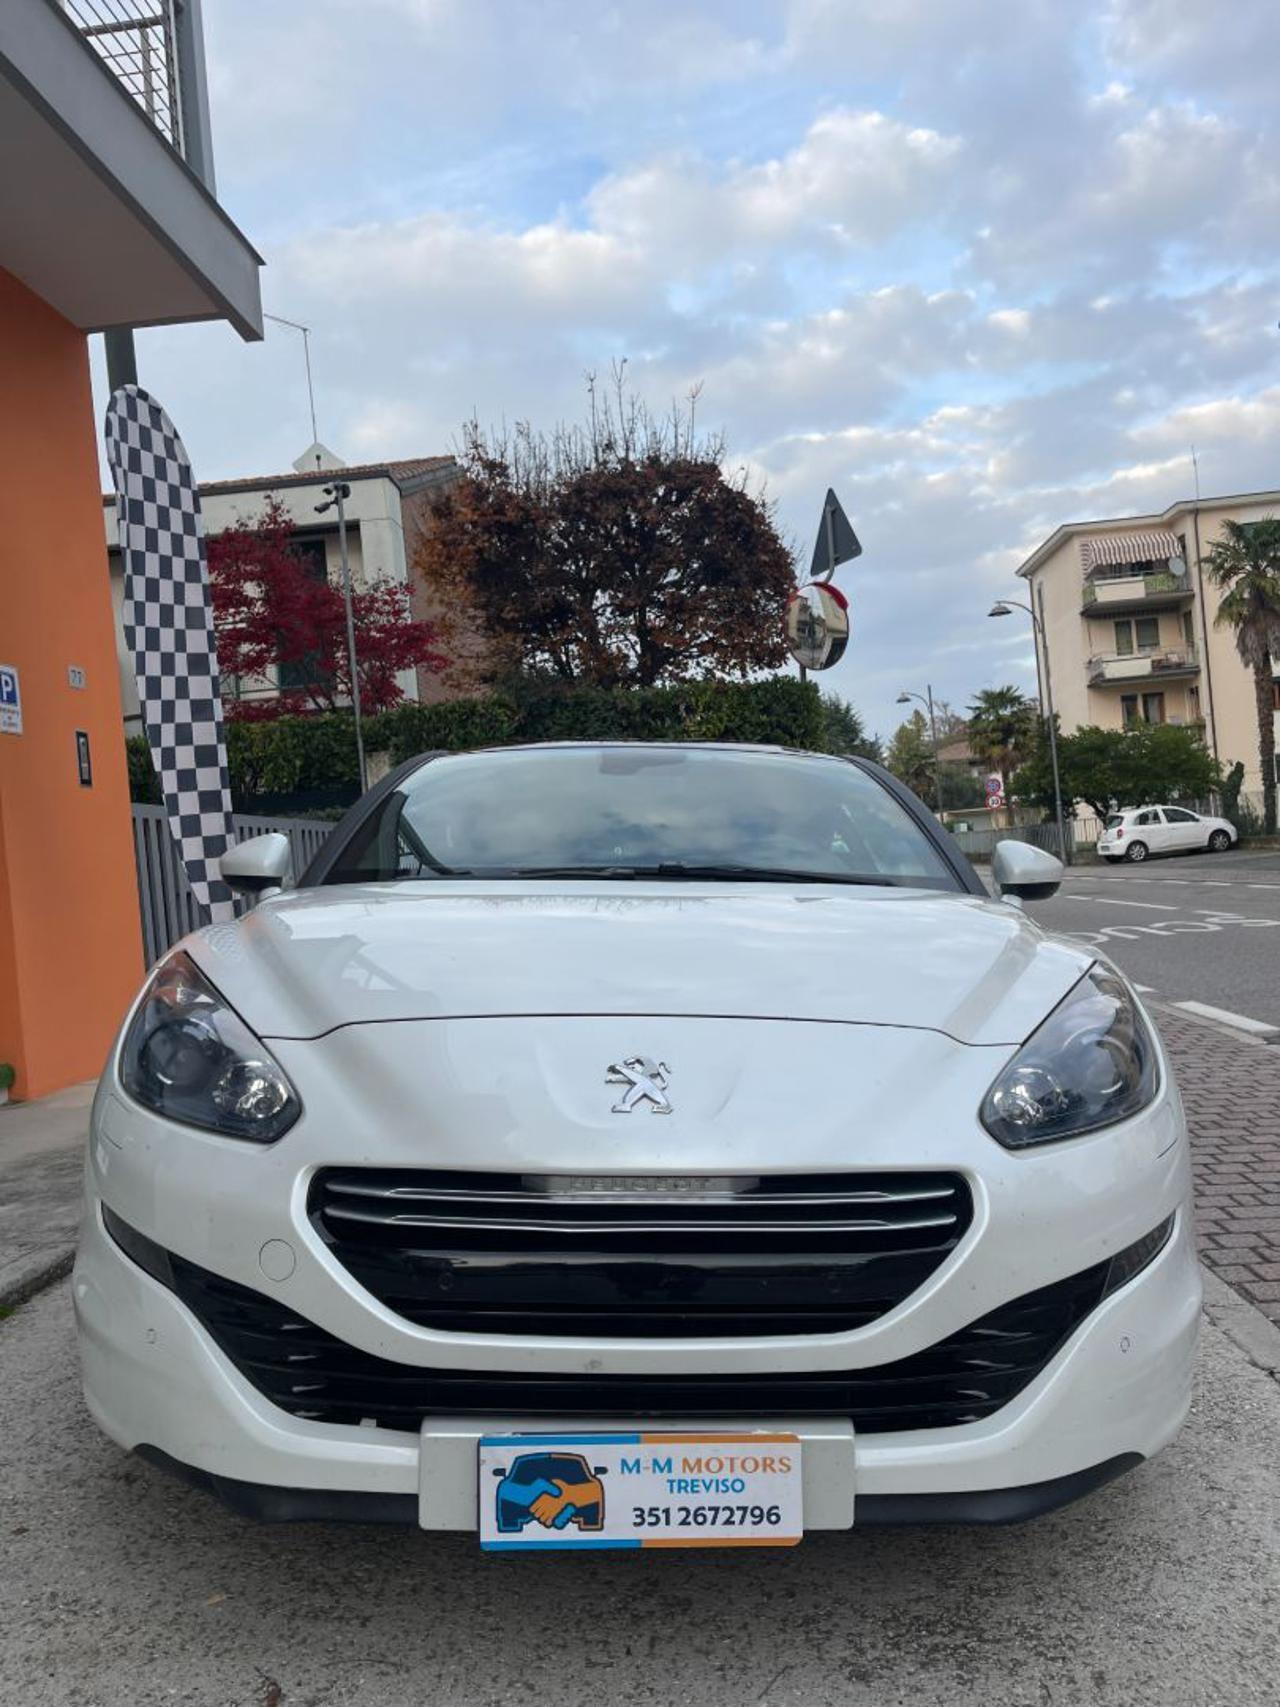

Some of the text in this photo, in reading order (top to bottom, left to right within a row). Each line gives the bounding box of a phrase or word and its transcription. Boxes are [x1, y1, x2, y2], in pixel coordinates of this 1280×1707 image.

[1, 675, 13, 700] P
[620, 1456, 792, 1474] M-M MOTORS
[666, 1478, 745, 1494] TREVISO
